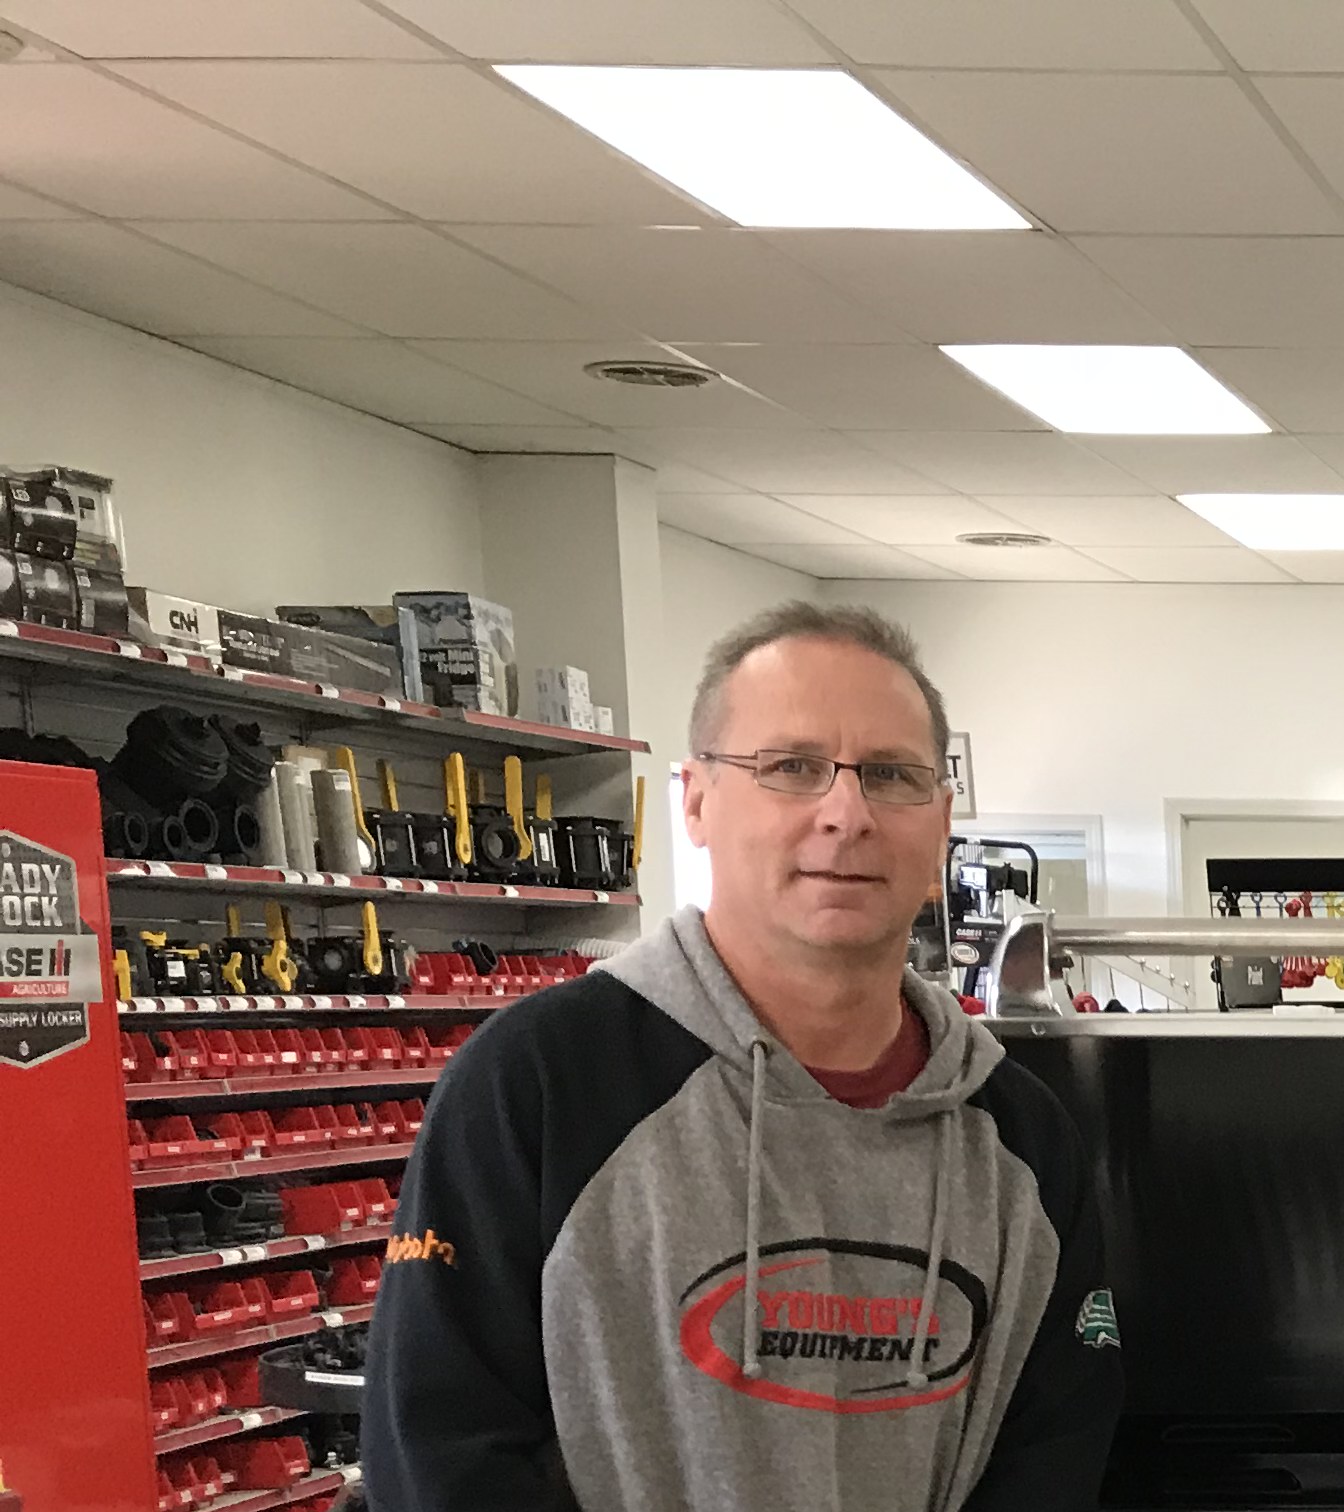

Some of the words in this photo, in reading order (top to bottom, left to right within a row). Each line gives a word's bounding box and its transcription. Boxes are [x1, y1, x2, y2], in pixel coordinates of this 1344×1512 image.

[0, 862, 62, 895] ADY
[2, 895, 63, 928] OCK
[12, 982, 68, 995] AGRICULTURE
[41, 1010, 82, 1027] LOCKER
[385, 1229, 458, 1266] ubota
